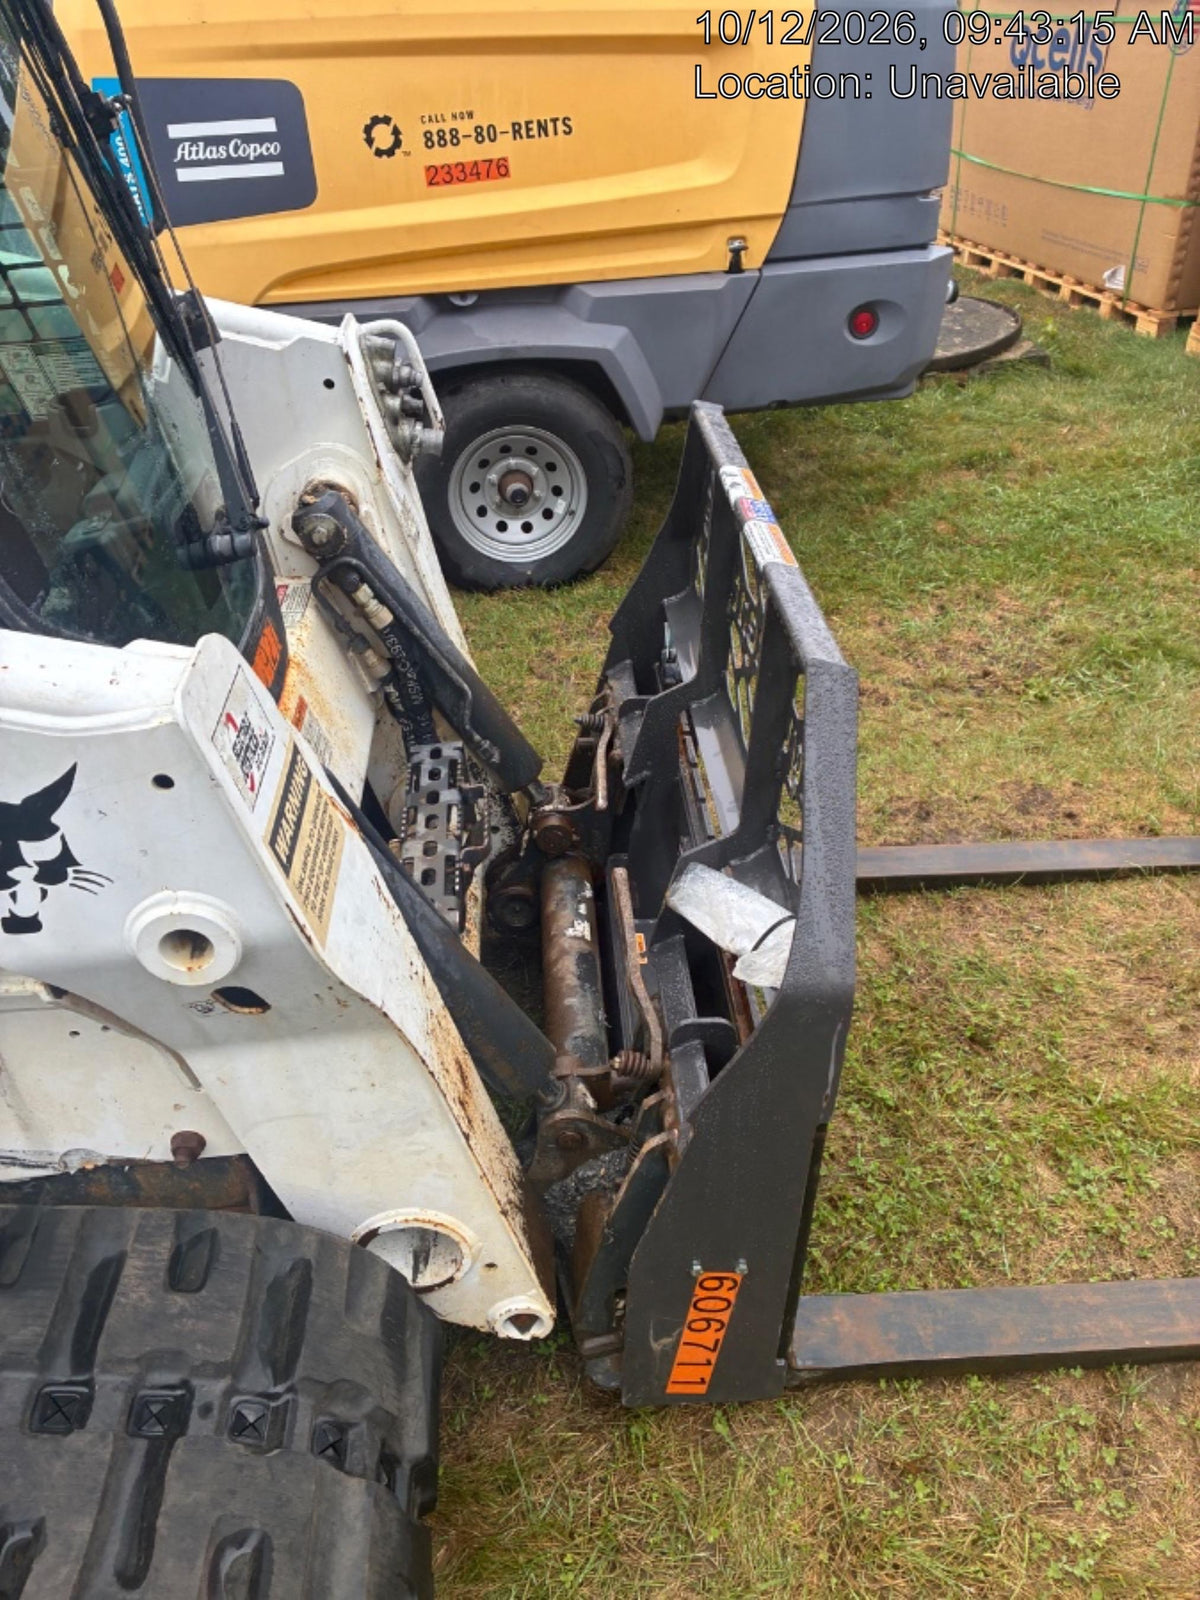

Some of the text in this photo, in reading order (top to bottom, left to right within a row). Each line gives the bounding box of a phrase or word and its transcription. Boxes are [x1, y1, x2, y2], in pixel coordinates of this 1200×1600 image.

[420, 110, 475, 125] CALL NOW
[423, 116, 573, 149] 888-80-RENTS
[173, 138, 281, 162] Atlas Copco
[427, 157, 511, 186] 233476
[275, 754, 309, 863] WARNING
[671, 1276, 738, 1385] 606711
